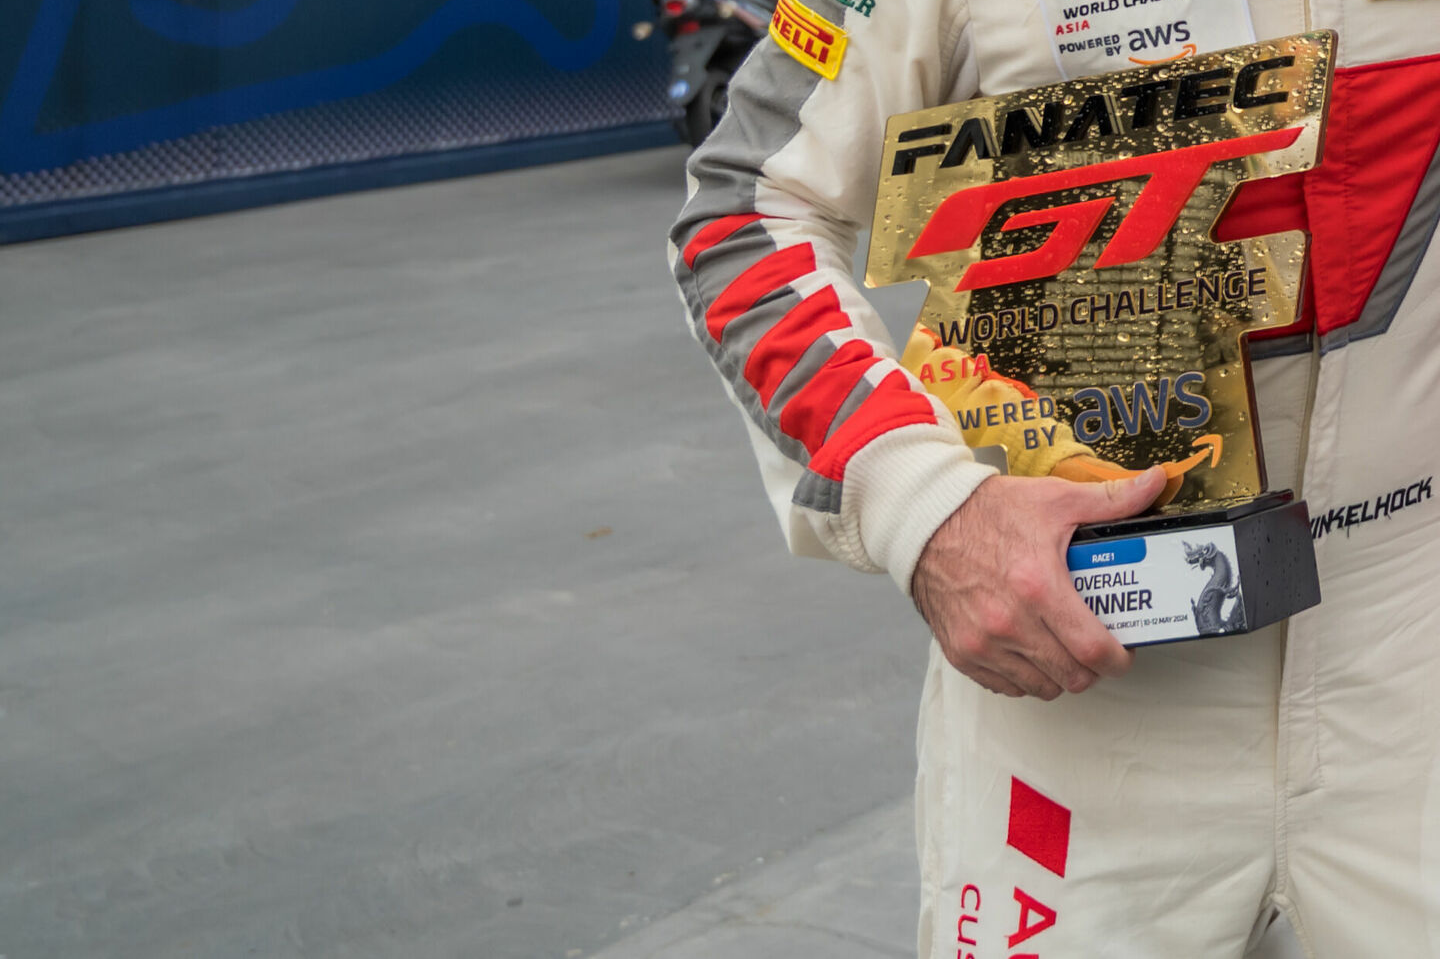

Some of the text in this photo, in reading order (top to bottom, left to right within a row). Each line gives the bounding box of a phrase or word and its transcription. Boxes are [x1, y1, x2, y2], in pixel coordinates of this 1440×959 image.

[1056, 20, 1090, 35] ASIA
[1059, 20, 1190, 54] POWERED aws
[1106, 45, 1121, 57] BY
[892, 55, 1295, 176] FANATEC
[906, 126, 1304, 292] GT
[939, 267, 1268, 347] WORLD CHALLENGE
[919, 353, 990, 385] ASIA
[957, 371, 1213, 443] WERED aws
[1023, 425, 1058, 450] BY
[1310, 476, 1433, 539] INKELHOCK
[1092, 553, 1110, 563] RACE
[1074, 570, 1139, 592] OVERALL
[1116, 620, 1140, 629] CIRCUIT
